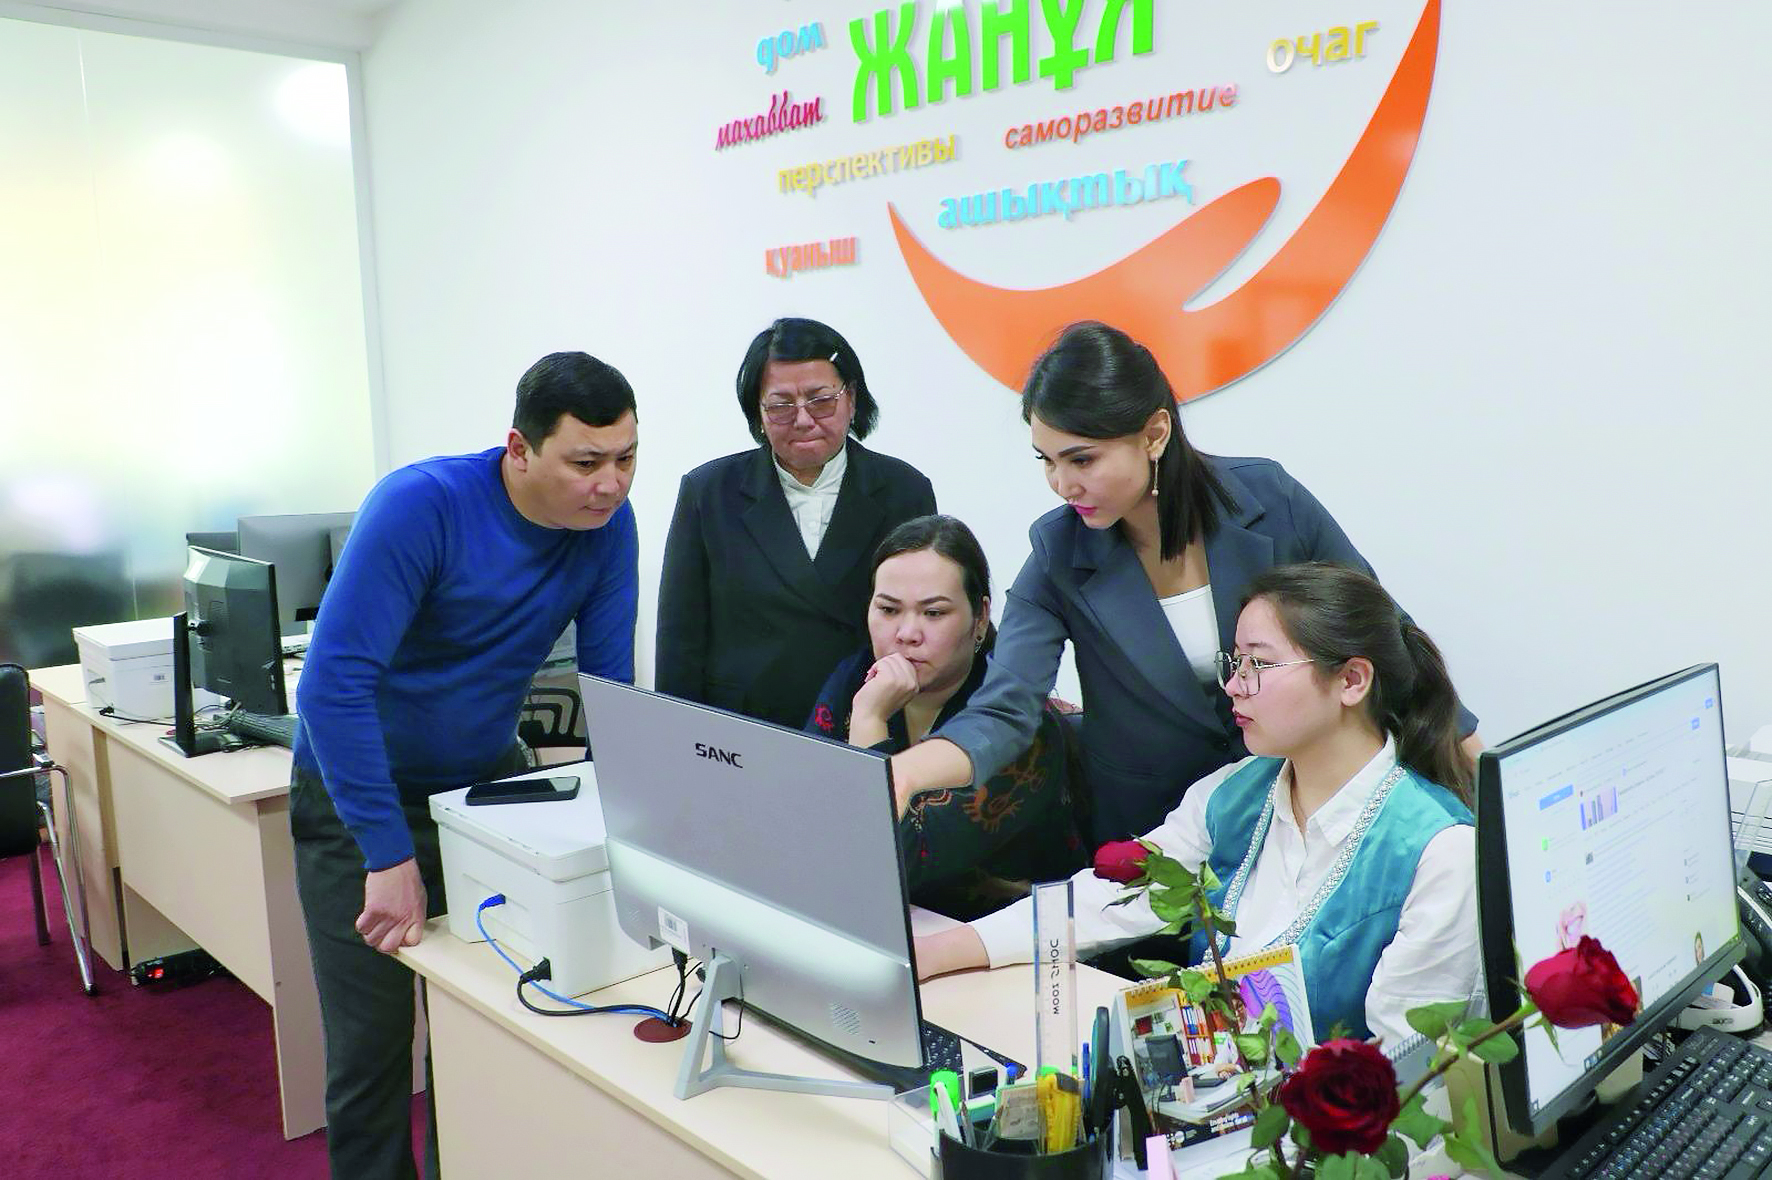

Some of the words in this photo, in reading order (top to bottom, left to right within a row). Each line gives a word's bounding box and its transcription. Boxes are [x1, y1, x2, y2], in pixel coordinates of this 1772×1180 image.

[756, 22, 823, 73] дом
[1266, 20, 1379, 74] очаг
[715, 90, 823, 151] махаббат
[1004, 82, 1238, 150] саморазвитие
[778, 133, 956, 196] перспективы
[937, 159, 1193, 229] ашықтық
[765, 236, 857, 280] қуаныш
[695, 742, 744, 769] SANC
